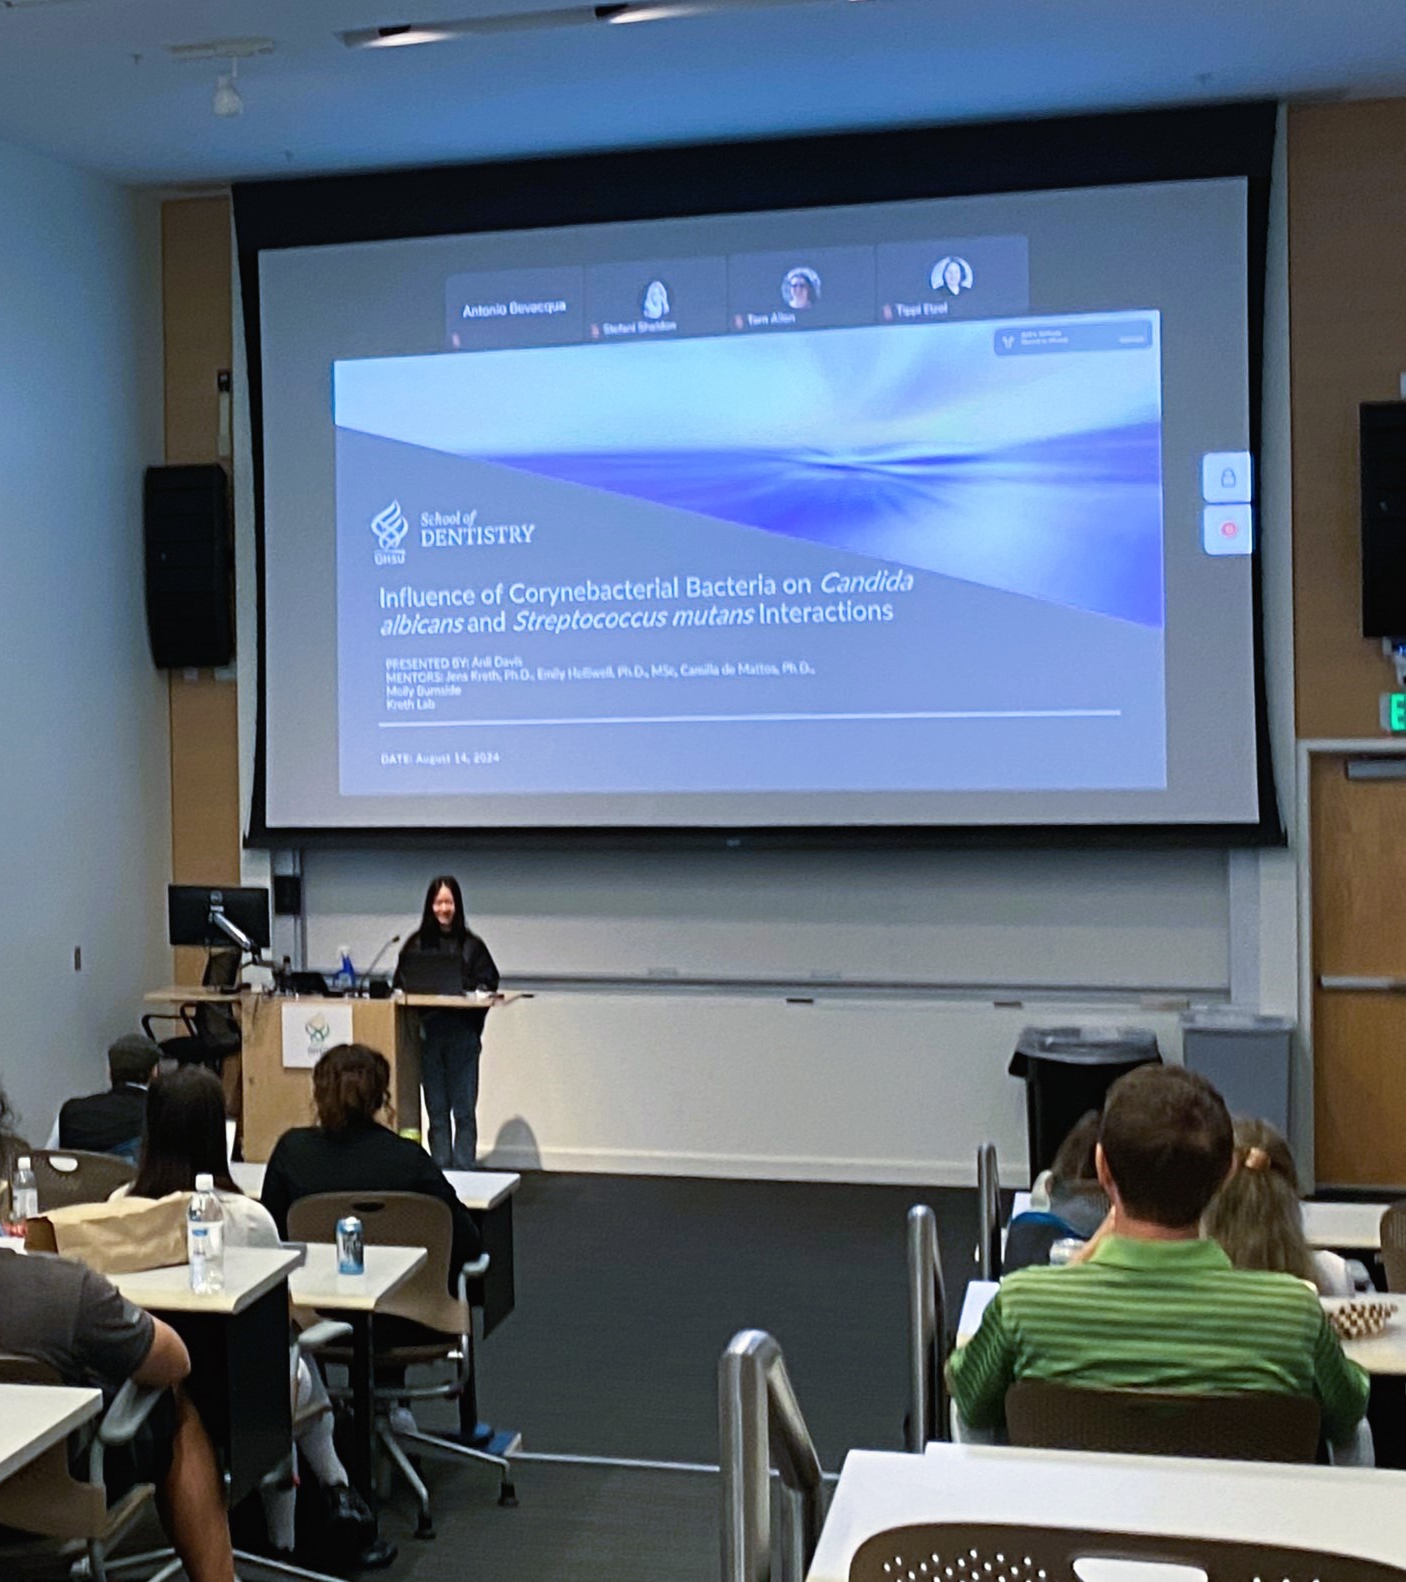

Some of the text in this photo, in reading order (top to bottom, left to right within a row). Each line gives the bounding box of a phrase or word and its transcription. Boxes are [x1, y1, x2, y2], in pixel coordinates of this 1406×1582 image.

[462, 302, 507, 318] Antonio
[420, 508, 478, 528] School of
[420, 523, 536, 548] DENTISTRY
[374, 552, 406, 566] OHSU
[380, 570, 915, 608] Influence of Corynebacterial Bacteria on Candida
[380, 600, 894, 636] albicans and Streptococcus mutans Interactions
[385, 657, 450, 672] PRESENTED
[386, 698, 436, 712] Kreth Lab
[415, 752, 451, 766] August
[473, 751, 500, 765] 2024
